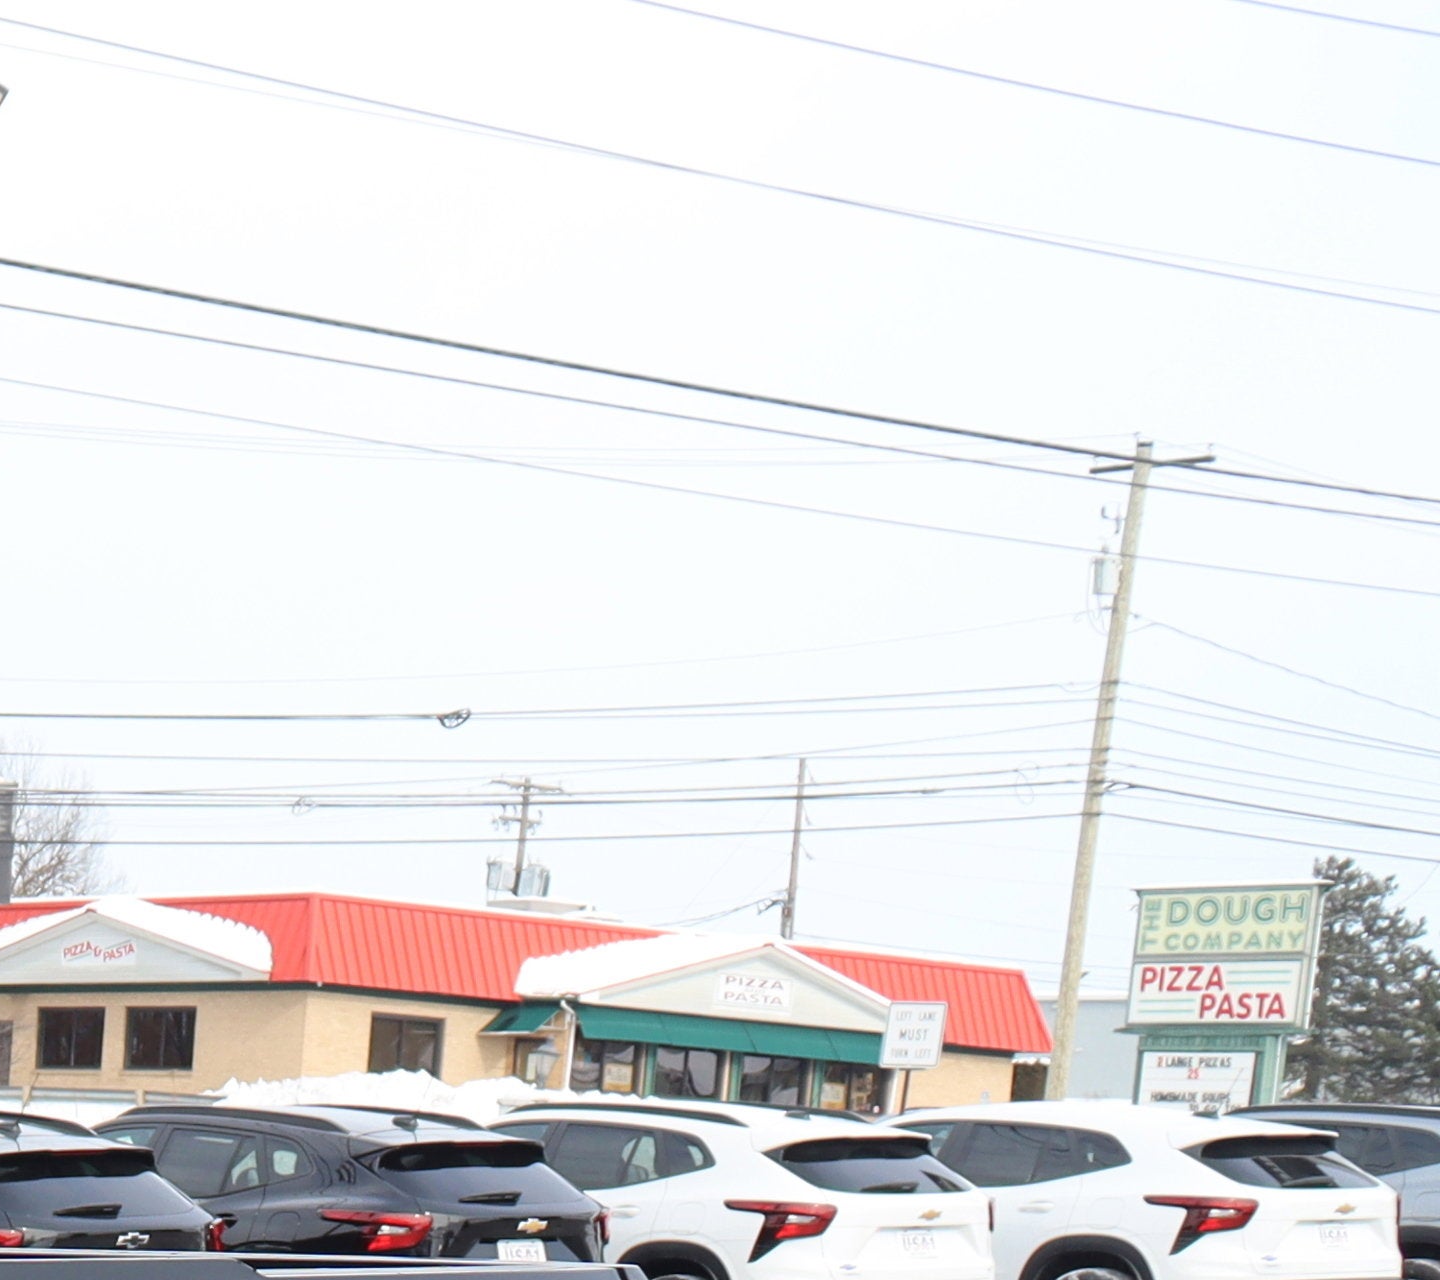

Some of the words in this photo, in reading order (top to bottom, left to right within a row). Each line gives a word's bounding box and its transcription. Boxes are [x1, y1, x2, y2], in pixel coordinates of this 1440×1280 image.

[1140, 898, 1162, 949] THE
[1167, 893, 1308, 927] DOUGH
[1164, 931, 1305, 951] COMPANY
[63, 941, 92, 958] PIZZA
[103, 943, 135, 962] PASTA
[725, 975, 785, 990] PIZZA
[1139, 965, 1224, 992] PIZZA
[723, 991, 783, 1006] PASTA
[1199, 993, 1286, 1020] PASTA
[898, 1028, 929, 1041] MUST
